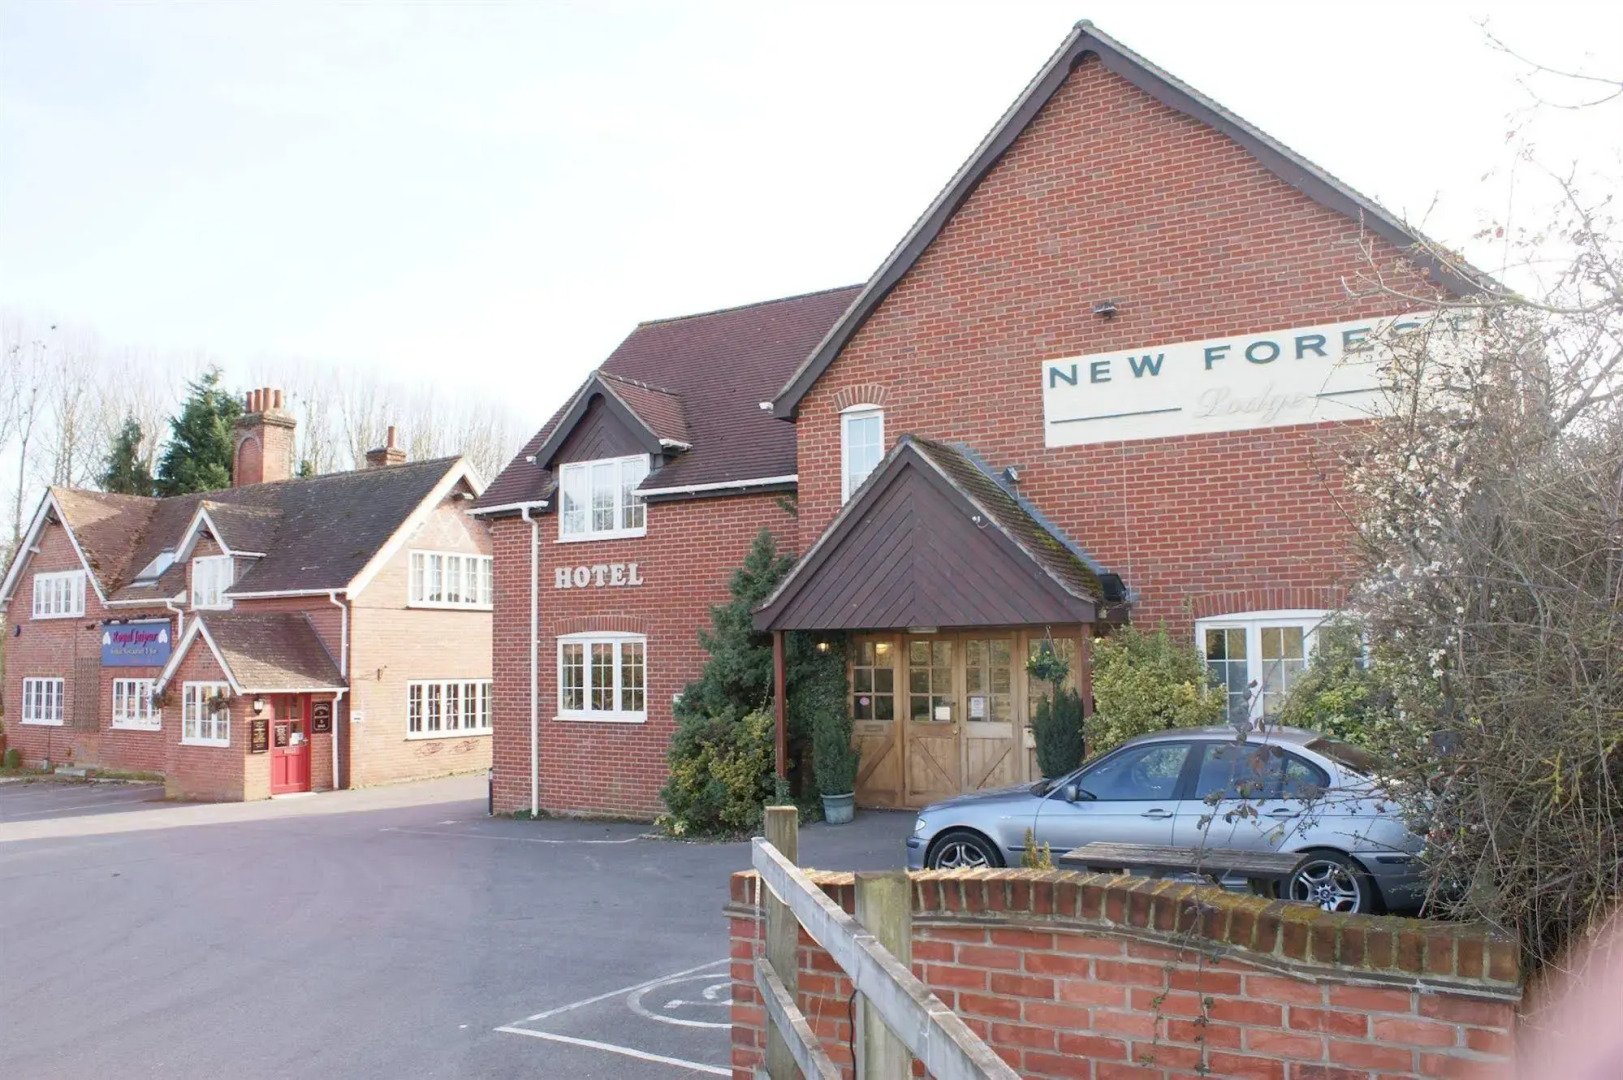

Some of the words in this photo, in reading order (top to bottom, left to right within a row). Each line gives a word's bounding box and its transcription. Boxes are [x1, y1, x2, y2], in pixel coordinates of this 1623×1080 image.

[1050, 353, 1165, 388] NEW
[1204, 316, 1468, 370] FORE
[1192, 381, 1307, 423] Lodge
[554, 563, 644, 589] HOTEL
